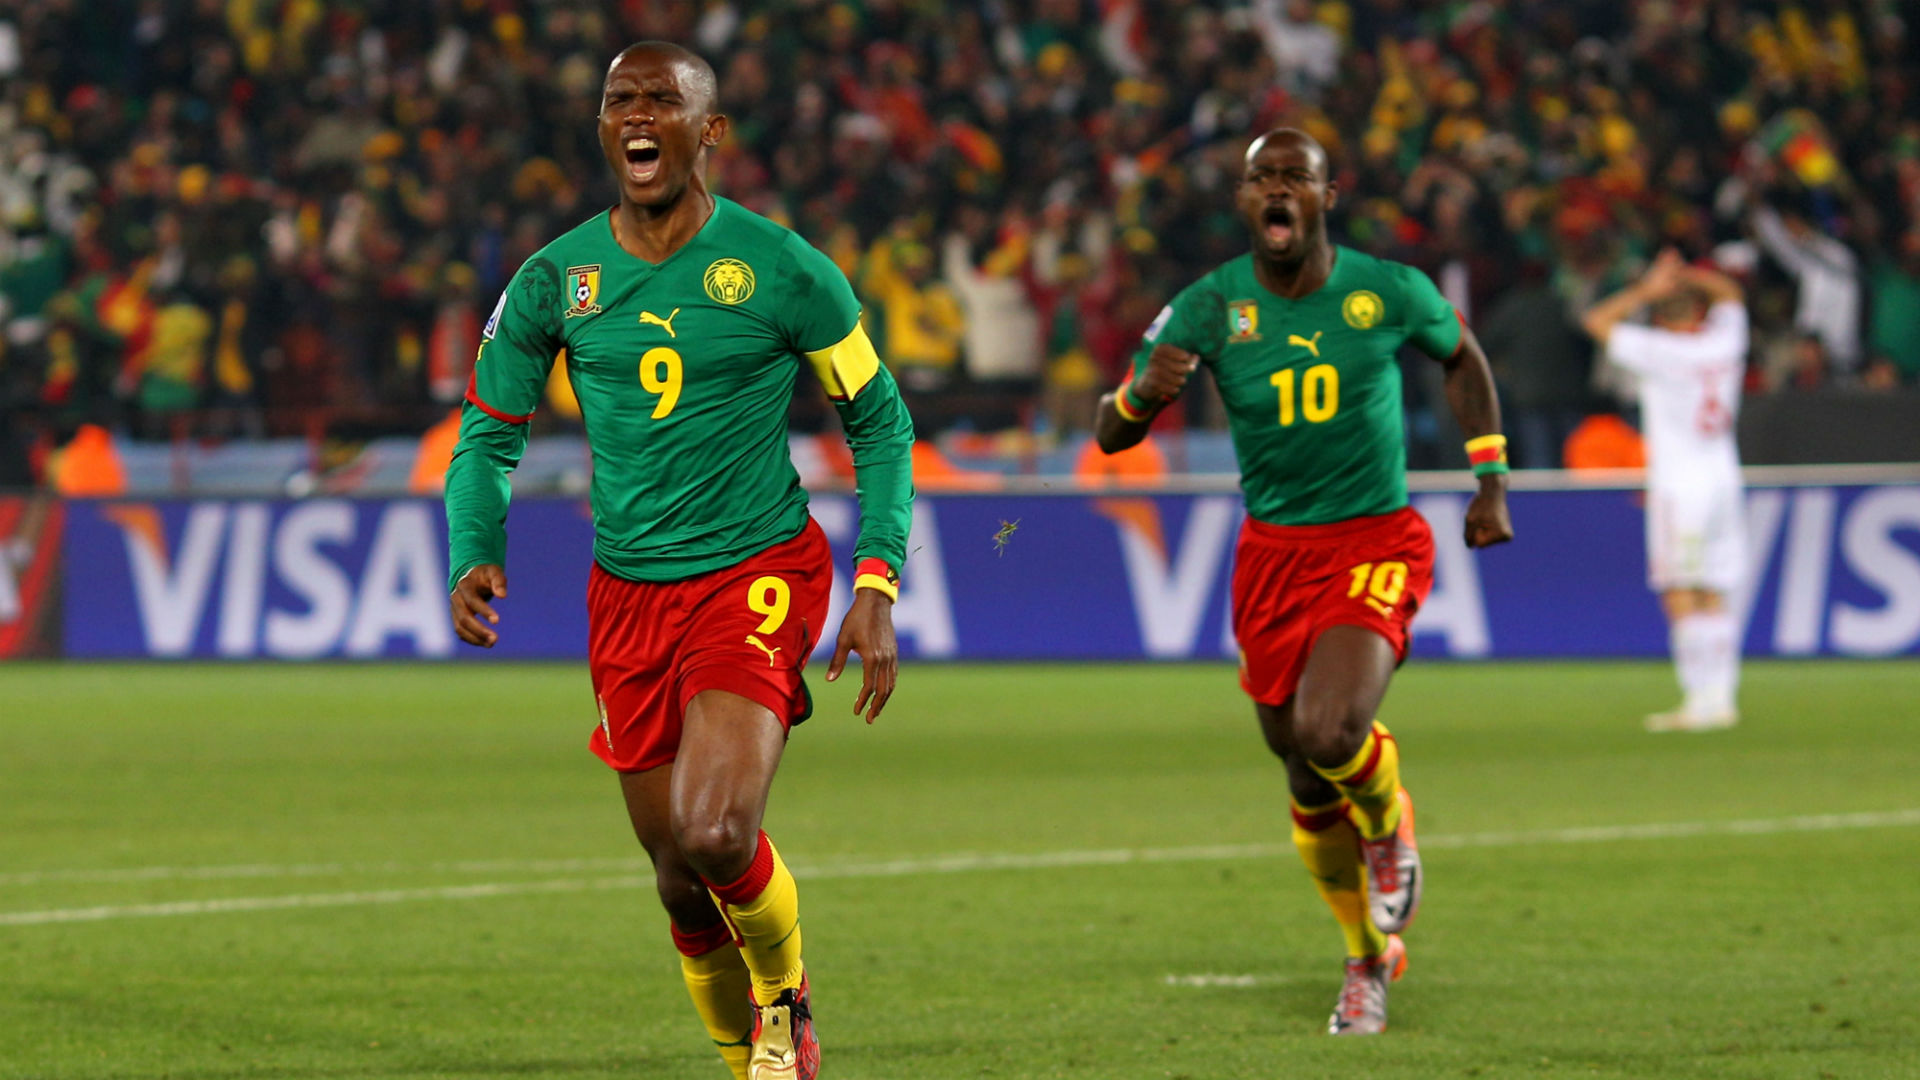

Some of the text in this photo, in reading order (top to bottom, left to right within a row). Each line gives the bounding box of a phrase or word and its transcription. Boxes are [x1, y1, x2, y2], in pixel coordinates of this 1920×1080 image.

[639, 346, 683, 419] 9
[1270, 363, 1339, 427] 10
[104, 501, 455, 659] VISA
[747, 575, 791, 635] 9
[1088, 494, 1492, 657] VA
[1347, 561, 1408, 605] 10
